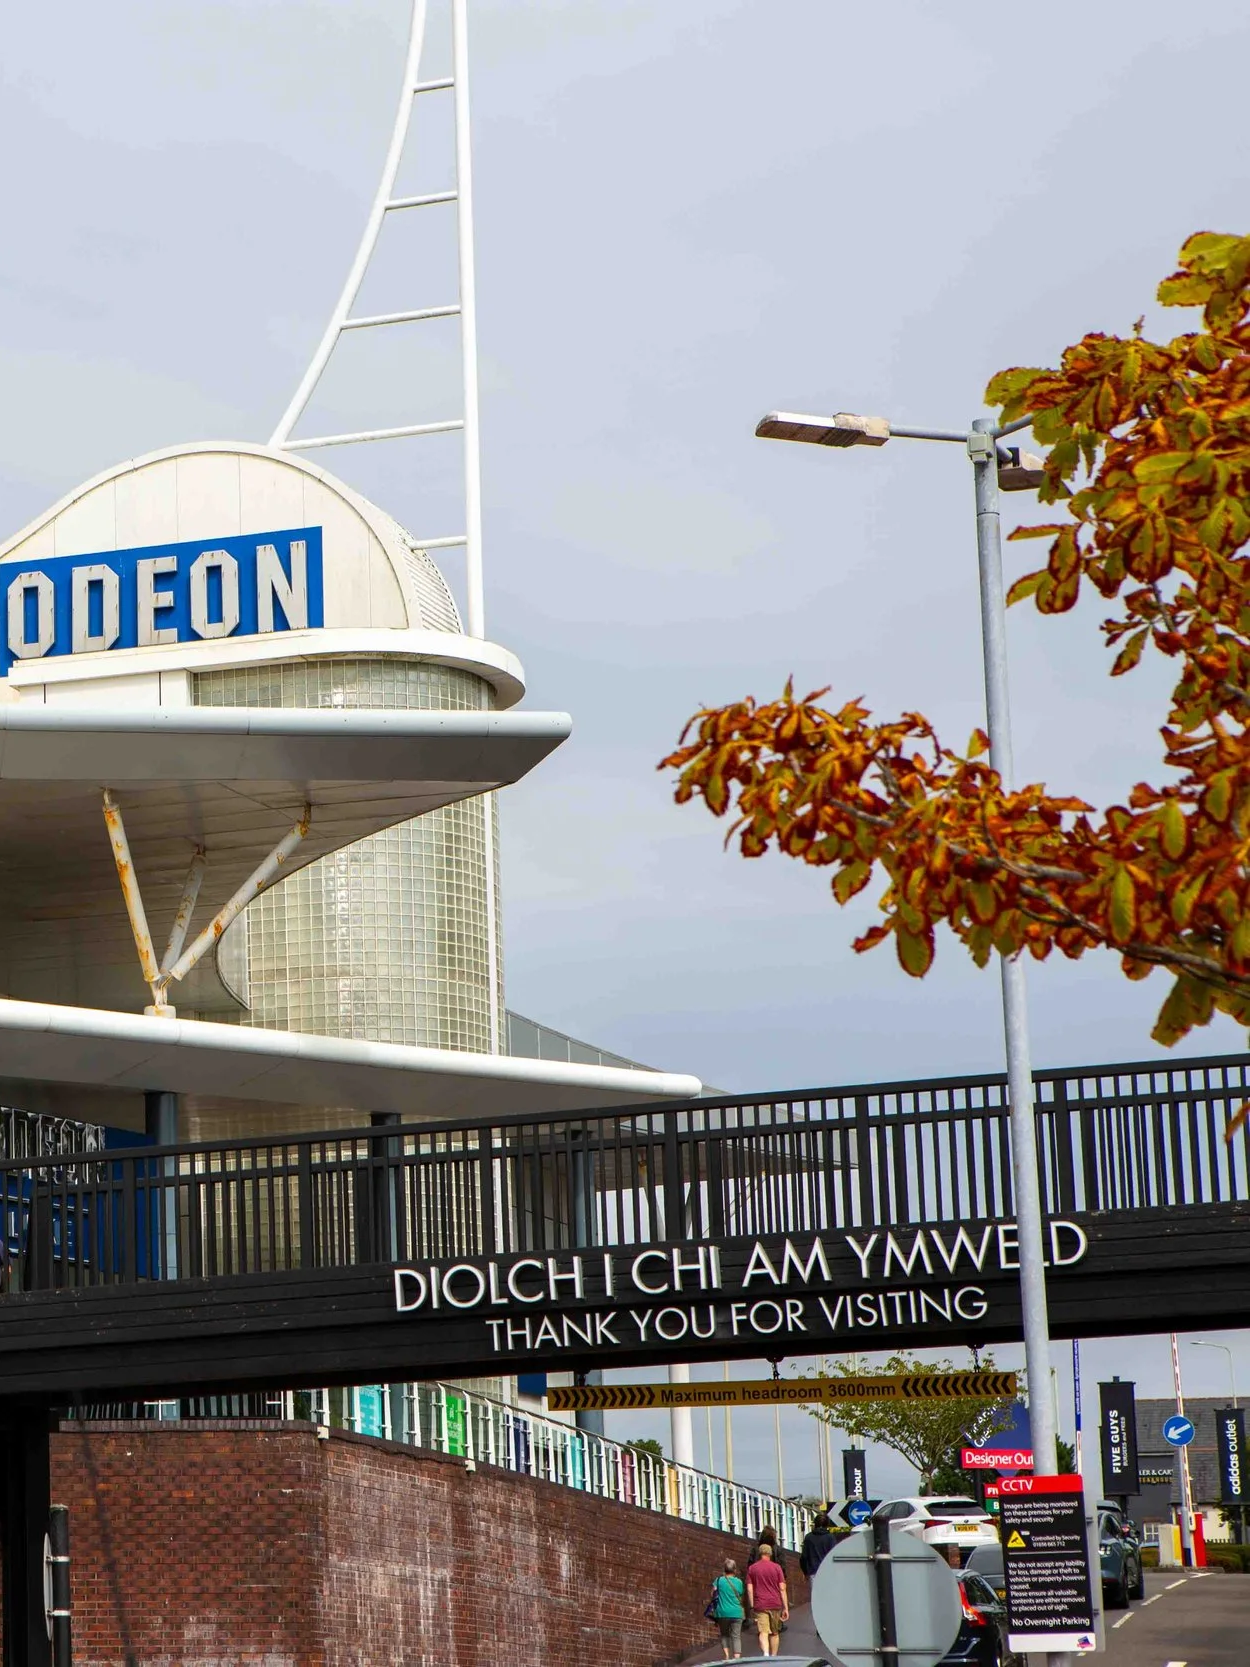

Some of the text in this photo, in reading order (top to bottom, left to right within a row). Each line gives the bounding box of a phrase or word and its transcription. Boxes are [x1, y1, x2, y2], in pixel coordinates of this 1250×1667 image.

[7, 540, 308, 659] ODEON
[394, 1221, 1088, 1311] DIOLCH I CHI AM YMWED
[485, 1286, 988, 1351] THANK YOU FOR VISITING
[660, 1383, 896, 1404] Maximum headroom 3600mm
[965, 1451, 1034, 1467] Designer Out
[1109, 1409, 1122, 1474] FIVE GUYS
[1225, 1419, 1241, 1495] adidas outlet
[1001, 1479, 1033, 1491] CCTV
[1003, 1502, 1023, 1510] Images
[1032, 1501, 1049, 1509] being
[1012, 1616, 1090, 1627] No Overnight Parking
